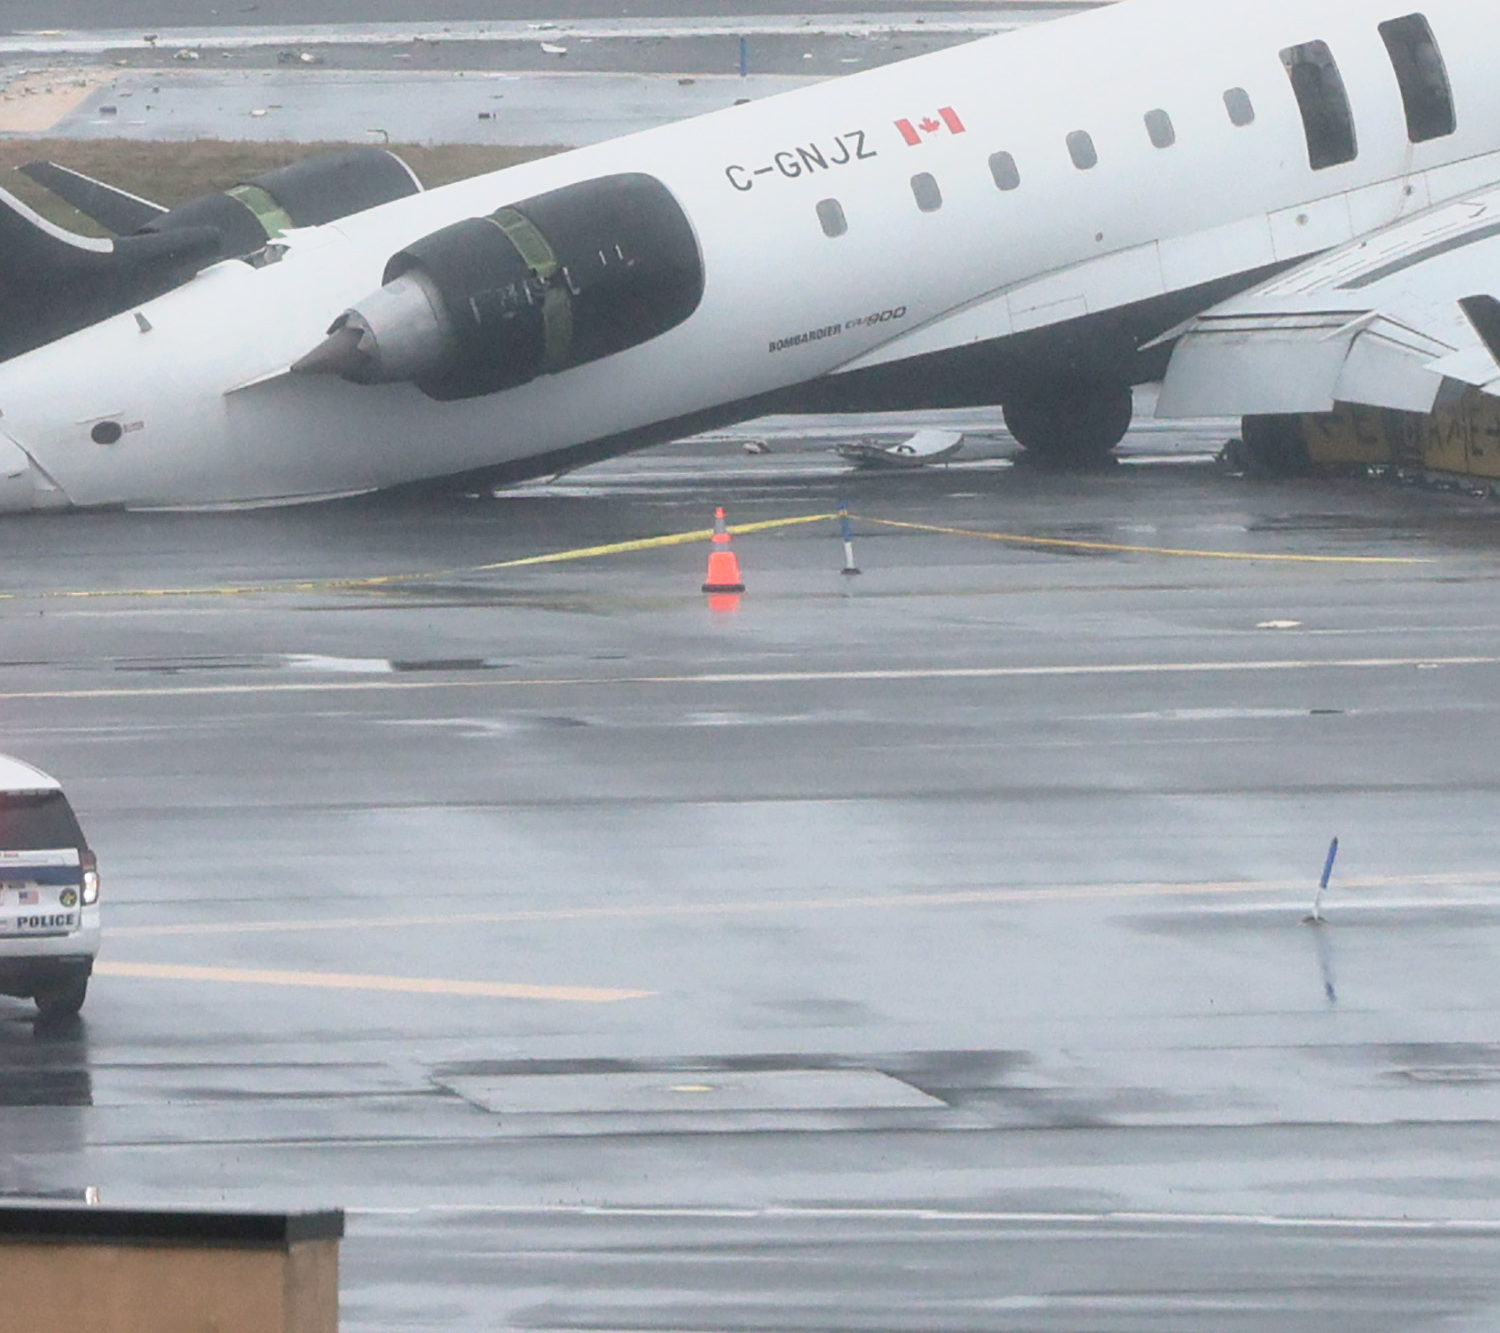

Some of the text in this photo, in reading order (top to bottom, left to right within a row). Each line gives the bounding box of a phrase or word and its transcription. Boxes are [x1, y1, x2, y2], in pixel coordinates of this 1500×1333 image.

[725, 130, 878, 192] C-GNJZ
[768, 324, 842, 353] BOMBARDIER
[17, 914, 75, 929] POLICE
